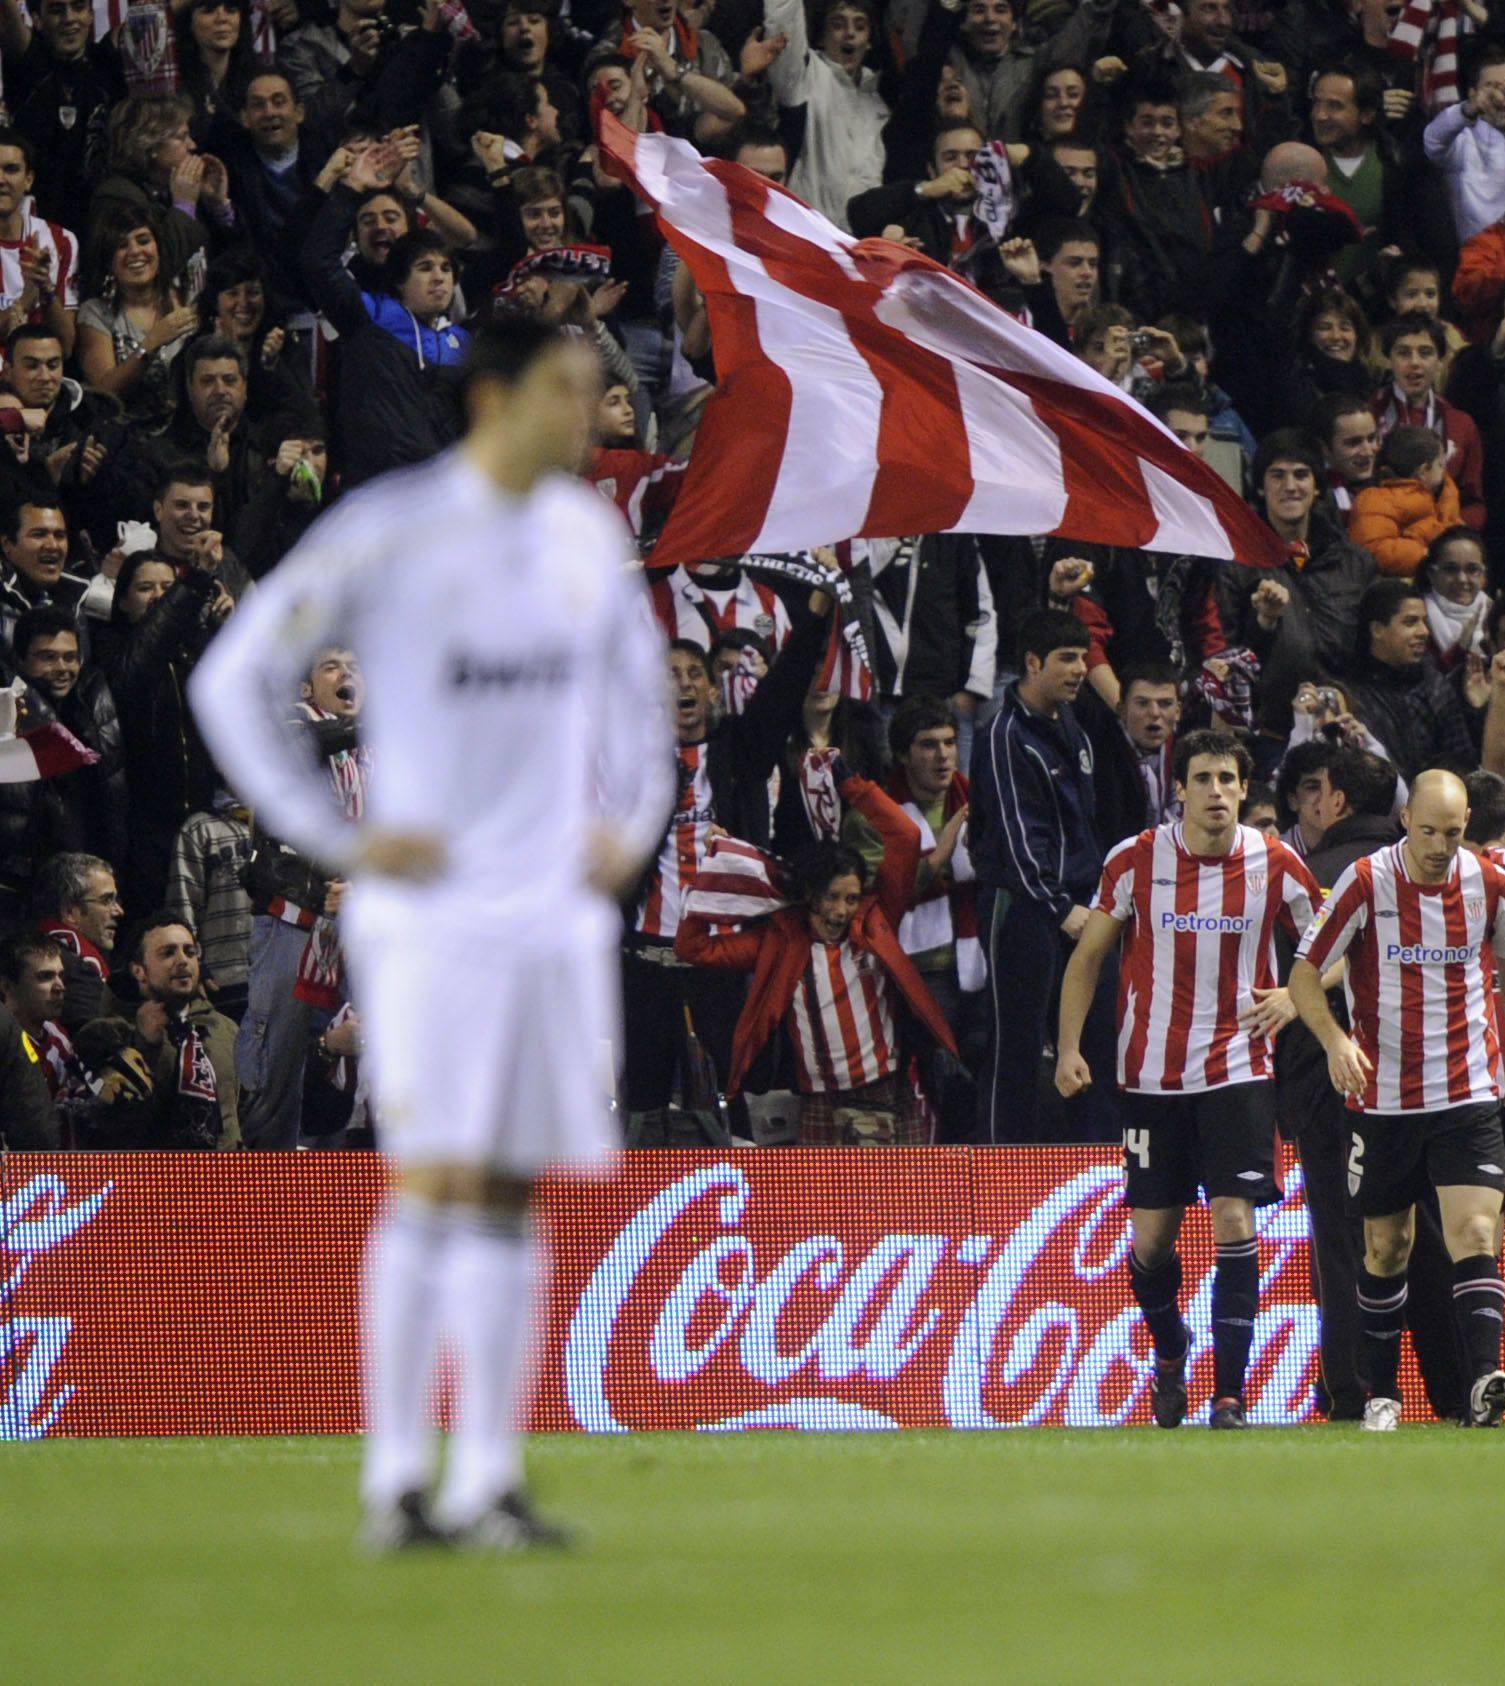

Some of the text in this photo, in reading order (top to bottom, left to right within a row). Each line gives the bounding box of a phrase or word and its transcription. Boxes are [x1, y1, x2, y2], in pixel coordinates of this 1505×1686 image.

[1161, 912, 1253, 932] Petronor
[1386, 943, 1476, 962] Petronor
[1123, 1127, 1150, 1169] 4
[1348, 1131, 1365, 1176] 2
